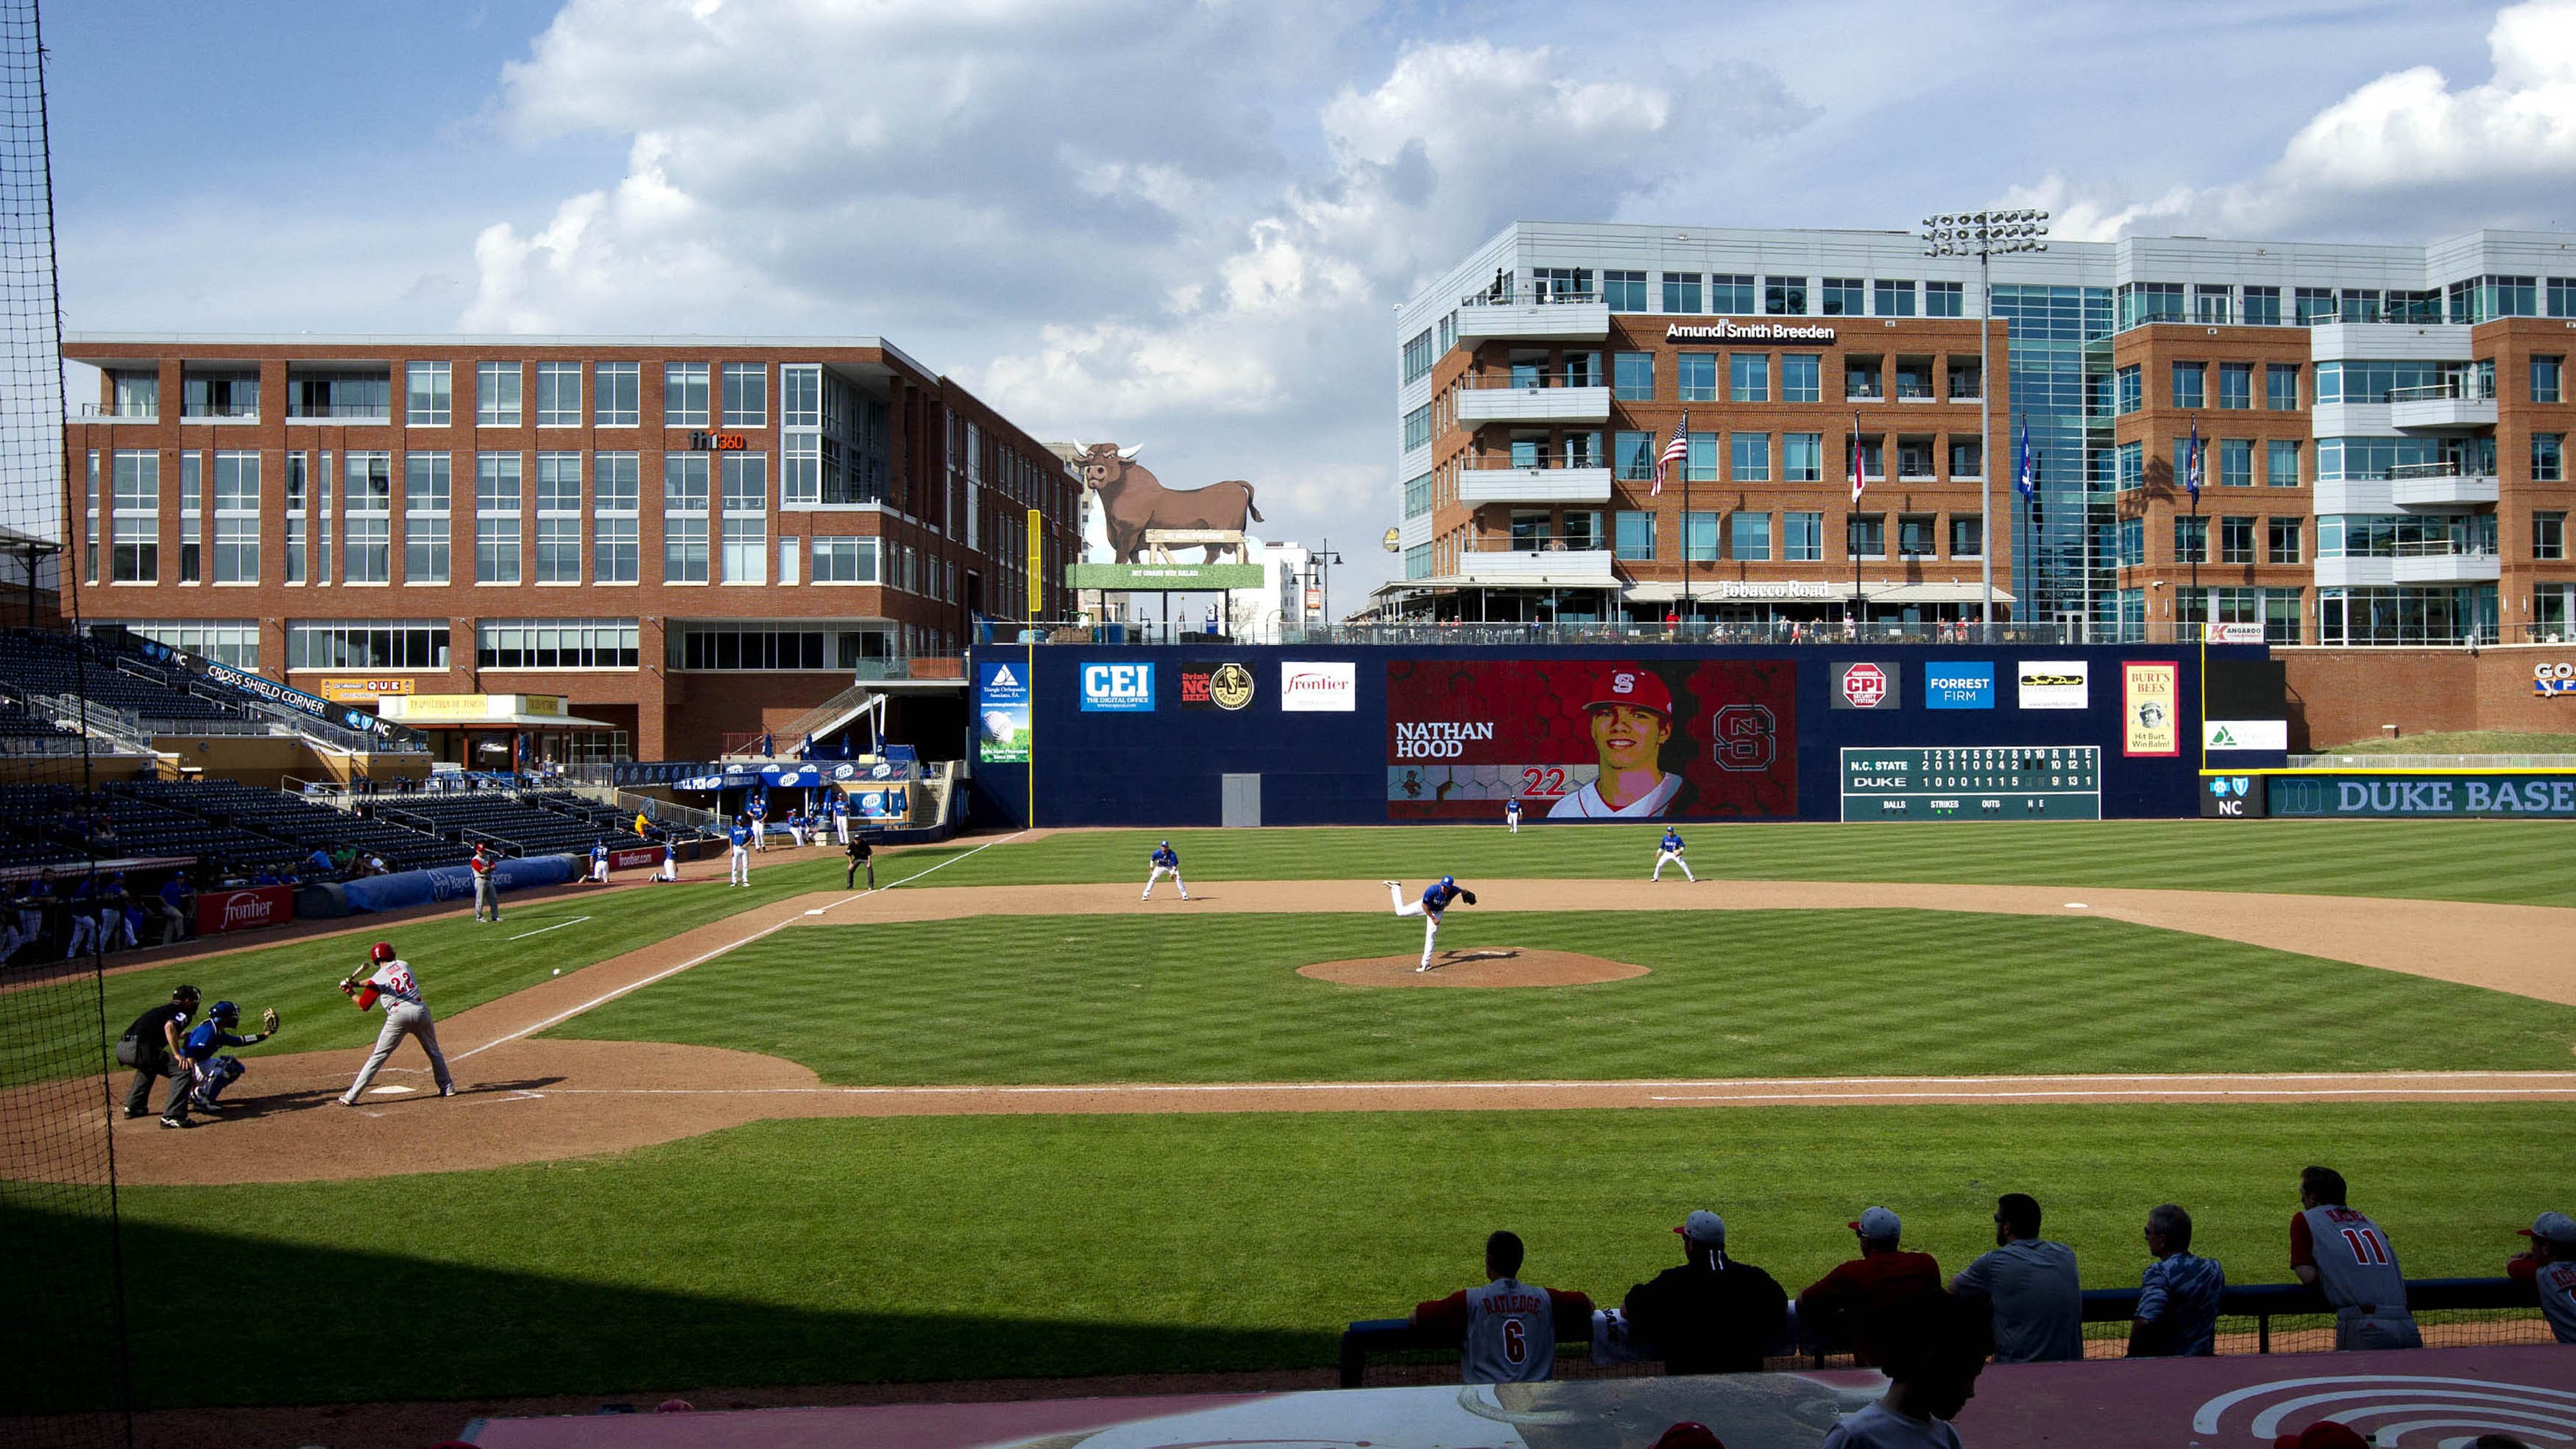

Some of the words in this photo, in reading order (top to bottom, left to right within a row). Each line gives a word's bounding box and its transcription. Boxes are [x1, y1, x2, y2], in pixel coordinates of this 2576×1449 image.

[1666, 324, 1726, 337] Amundi
[1727, 324, 1771, 338] Smith
[1773, 325, 1834, 339] Breeden
[1719, 581, 1785, 597] Tobacco
[1788, 581, 1828, 597] Road
[171, 652, 188, 666] NC
[2132, 673, 2170, 682] BURT'S
[2535, 663, 2576, 679] GO
[368, 681, 400, 691] QUE
[1086, 665, 1148, 697] CEI
[1182, 681, 1209, 693] NC
[1284, 673, 1348, 695] frontier
[1847, 679, 1883, 692] CPI
[1931, 679, 1989, 689] FORREST
[2137, 684, 2165, 692] BEES
[208, 665, 242, 686] CROSS
[243, 677, 280, 698] SHIELD
[281, 690, 325, 713] CORNER
[1945, 691, 1976, 701] FIRM
[373, 721, 391, 736] NC
[1396, 722, 1494, 740] NATHAN
[1396, 740, 1463, 757] HOOD
[1923, 749, 1928, 759] 1
[1936, 749, 1942, 759] 2
[1948, 749, 1955, 759] 3
[1961, 749, 1967, 759] 4
[1973, 749, 1980, 759] 5
[1986, 749, 1992, 759] 6
[1998, 749, 2005, 759] 7
[2011, 749, 2018, 759] 8
[2025, 749, 2031, 759] 9
[2035, 749, 2045, 759] 10
[2052, 749, 2059, 759] R
[2069, 749, 2076, 759] H
[2085, 749, 2091, 759] E
[1851, 762, 1872, 770] N.C.
[1875, 762, 1908, 770] STATE
[1922, 761, 1928, 770] 2
[1935, 761, 1942, 770] 0
[1949, 761, 1954, 770] 1
[1961, 761, 1967, 770] 1
[1973, 761, 1980, 770] 0
[1986, 761, 1992, 770] 0
[1998, 761, 2005, 770] 4
[2011, 761, 2018, 770] 2
[2050, 761, 2061, 770] 10
[2067, 761, 2078, 770] 12
[2085, 761, 2090, 770] 1
[1523, 768, 1566, 797] 22
[1854, 778, 1906, 787] DUKE
[1923, 777, 1928, 787] 1
[1935, 777, 1942, 787] 0
[1948, 777, 1955, 787] 0
[1961, 777, 1967, 787] 0
[1974, 776, 1979, 786] 1
[1987, 776, 1992, 786] 1
[1999, 776, 2004, 786] 1
[2011, 776, 2018, 786] 5
[2052, 776, 2059, 786] 9
[2067, 776, 2078, 786] 13
[2085, 776, 2091, 786] 1
[2338, 782, 2453, 812] DUKE
[2465, 781, 2576, 812] BASE
[2219, 801, 2243, 815] NC
[619, 853, 652, 866] frontier.com
[221, 892, 273, 929] frontier
[391, 972, 414, 996] 22
[2341, 1228, 2389, 1265] 11
[1482, 1295, 1541, 1315] RATLEDGE
[1502, 1319, 1527, 1364] 6
